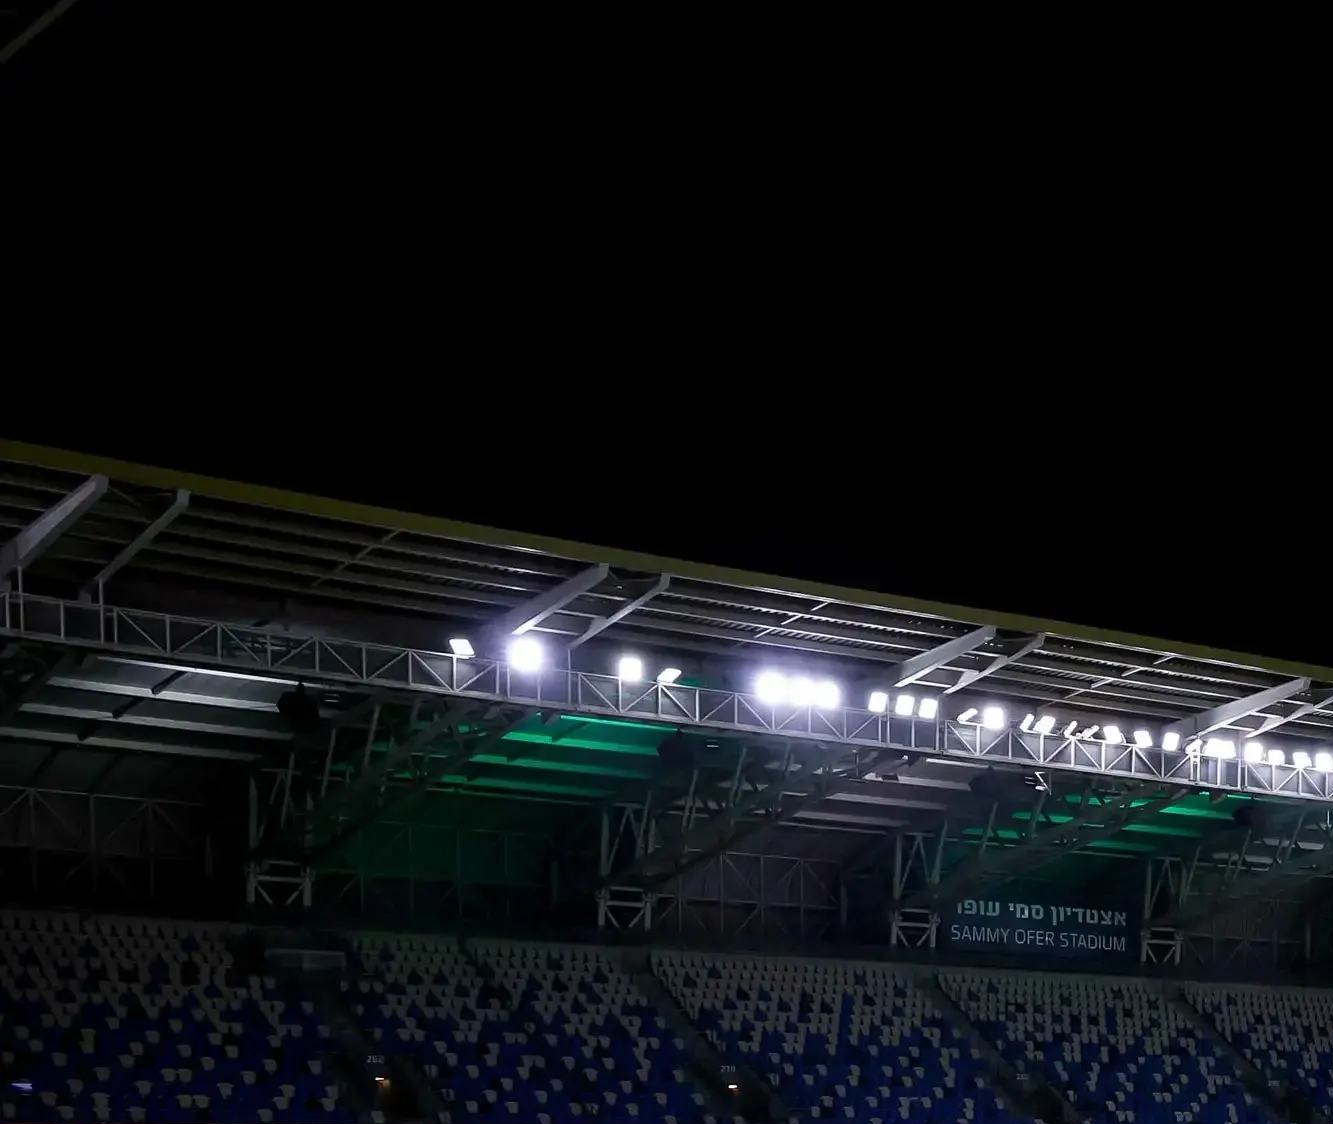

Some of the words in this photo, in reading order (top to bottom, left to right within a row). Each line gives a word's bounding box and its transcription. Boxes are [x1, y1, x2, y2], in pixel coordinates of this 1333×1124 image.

[1008, 902, 1044, 919] סמי
[1050, 905, 1127, 926] אצטדיון
[951, 925, 1010, 943] SAMMY
[1015, 929, 1054, 946] OFER
[1060, 932, 1126, 951] STADIUM
